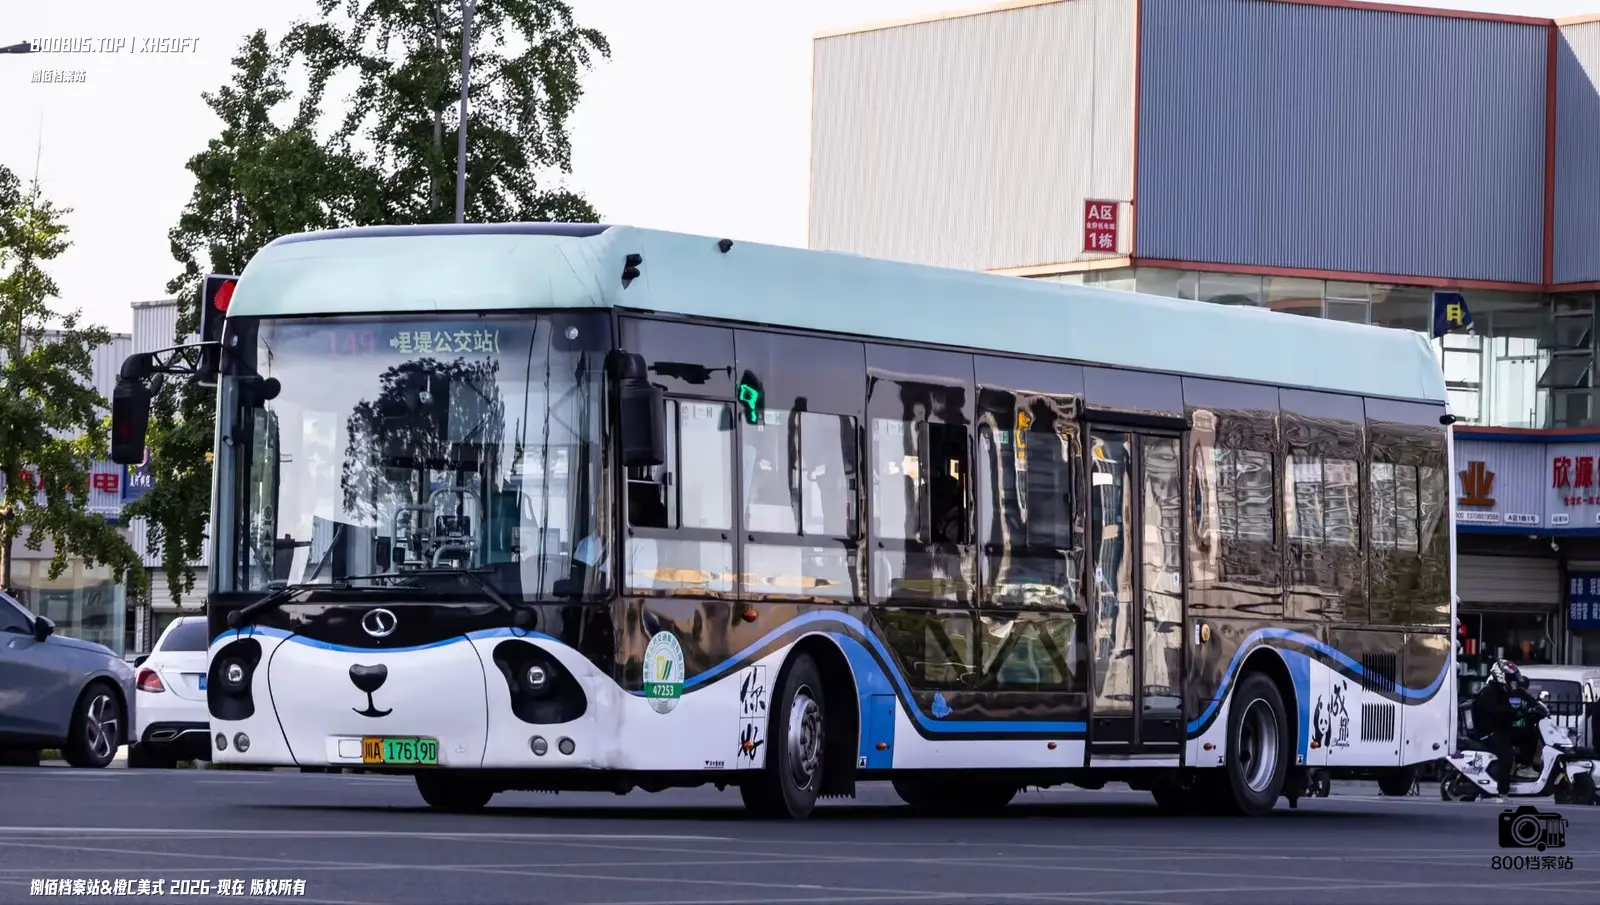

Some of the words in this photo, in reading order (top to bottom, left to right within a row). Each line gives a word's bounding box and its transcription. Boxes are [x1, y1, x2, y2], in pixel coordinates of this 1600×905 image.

[1088, 204, 1113, 220] A区
[1089, 232, 1113, 249] 1栋
[1552, 456, 1600, 489] 欣源
[652, 684, 674, 697] 47253
[364, 741, 381, 760] 川A
[388, 741, 437, 761] 17619D
